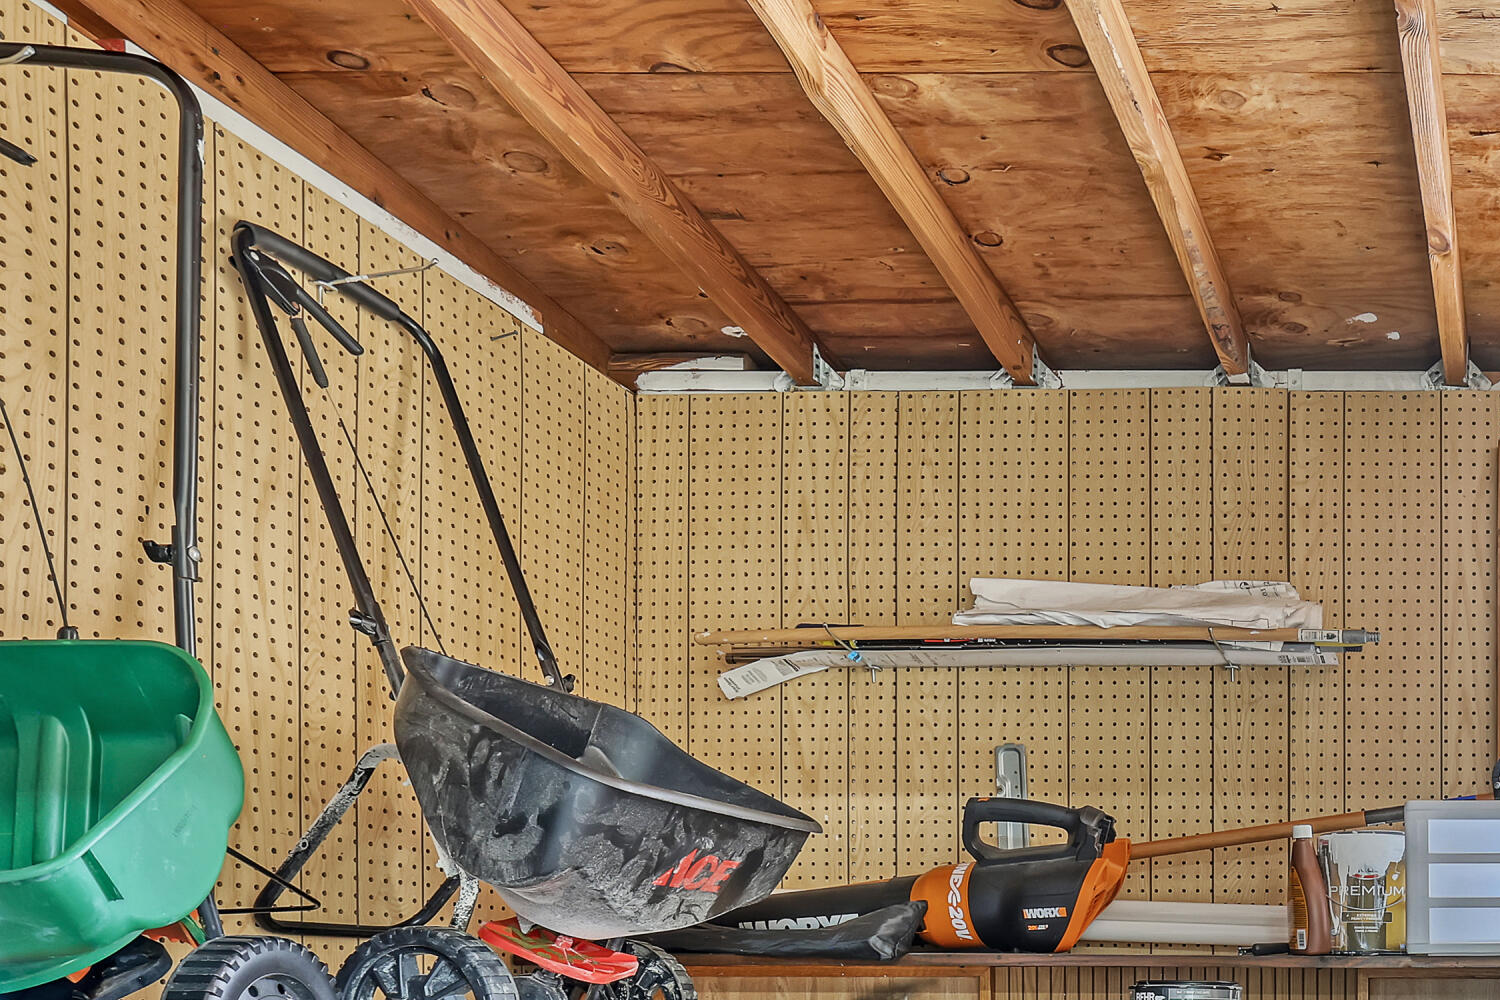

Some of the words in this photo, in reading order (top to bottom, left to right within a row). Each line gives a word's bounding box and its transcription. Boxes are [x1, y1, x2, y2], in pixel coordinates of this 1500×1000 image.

[652, 848, 742, 893] ACE
[1330, 885, 1405, 897] PREMIUM
[948, 905, 973, 940] 20V
[1027, 907, 1059, 918] WORX
